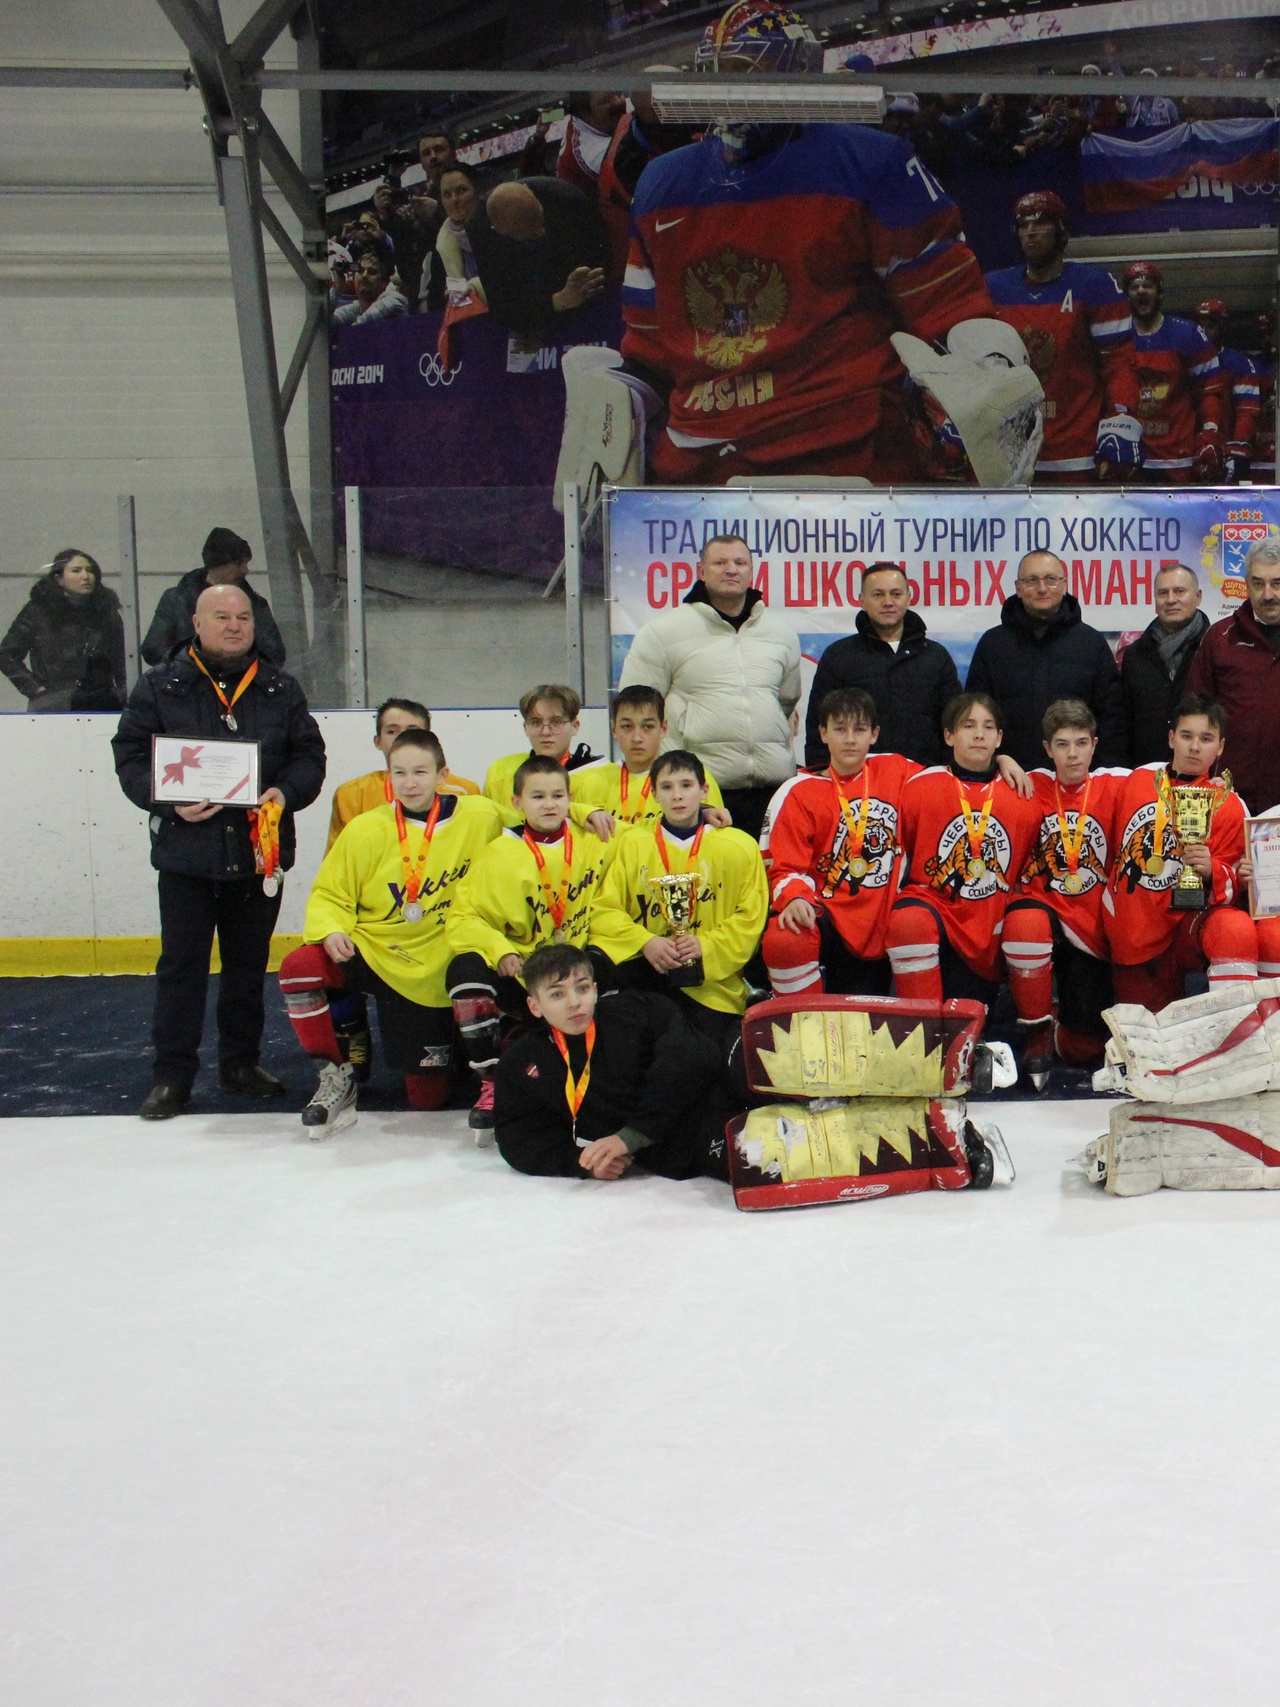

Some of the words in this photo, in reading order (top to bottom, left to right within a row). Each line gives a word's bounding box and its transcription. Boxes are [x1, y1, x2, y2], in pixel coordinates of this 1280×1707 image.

[1060, 289, 1074, 313] A
[356, 364, 384, 384] 2014
[894, 517, 1006, 552] ТУРНИР
[1015, 517, 1050, 552] ПО
[1060, 517, 1181, 552] ХОККЕЮ
